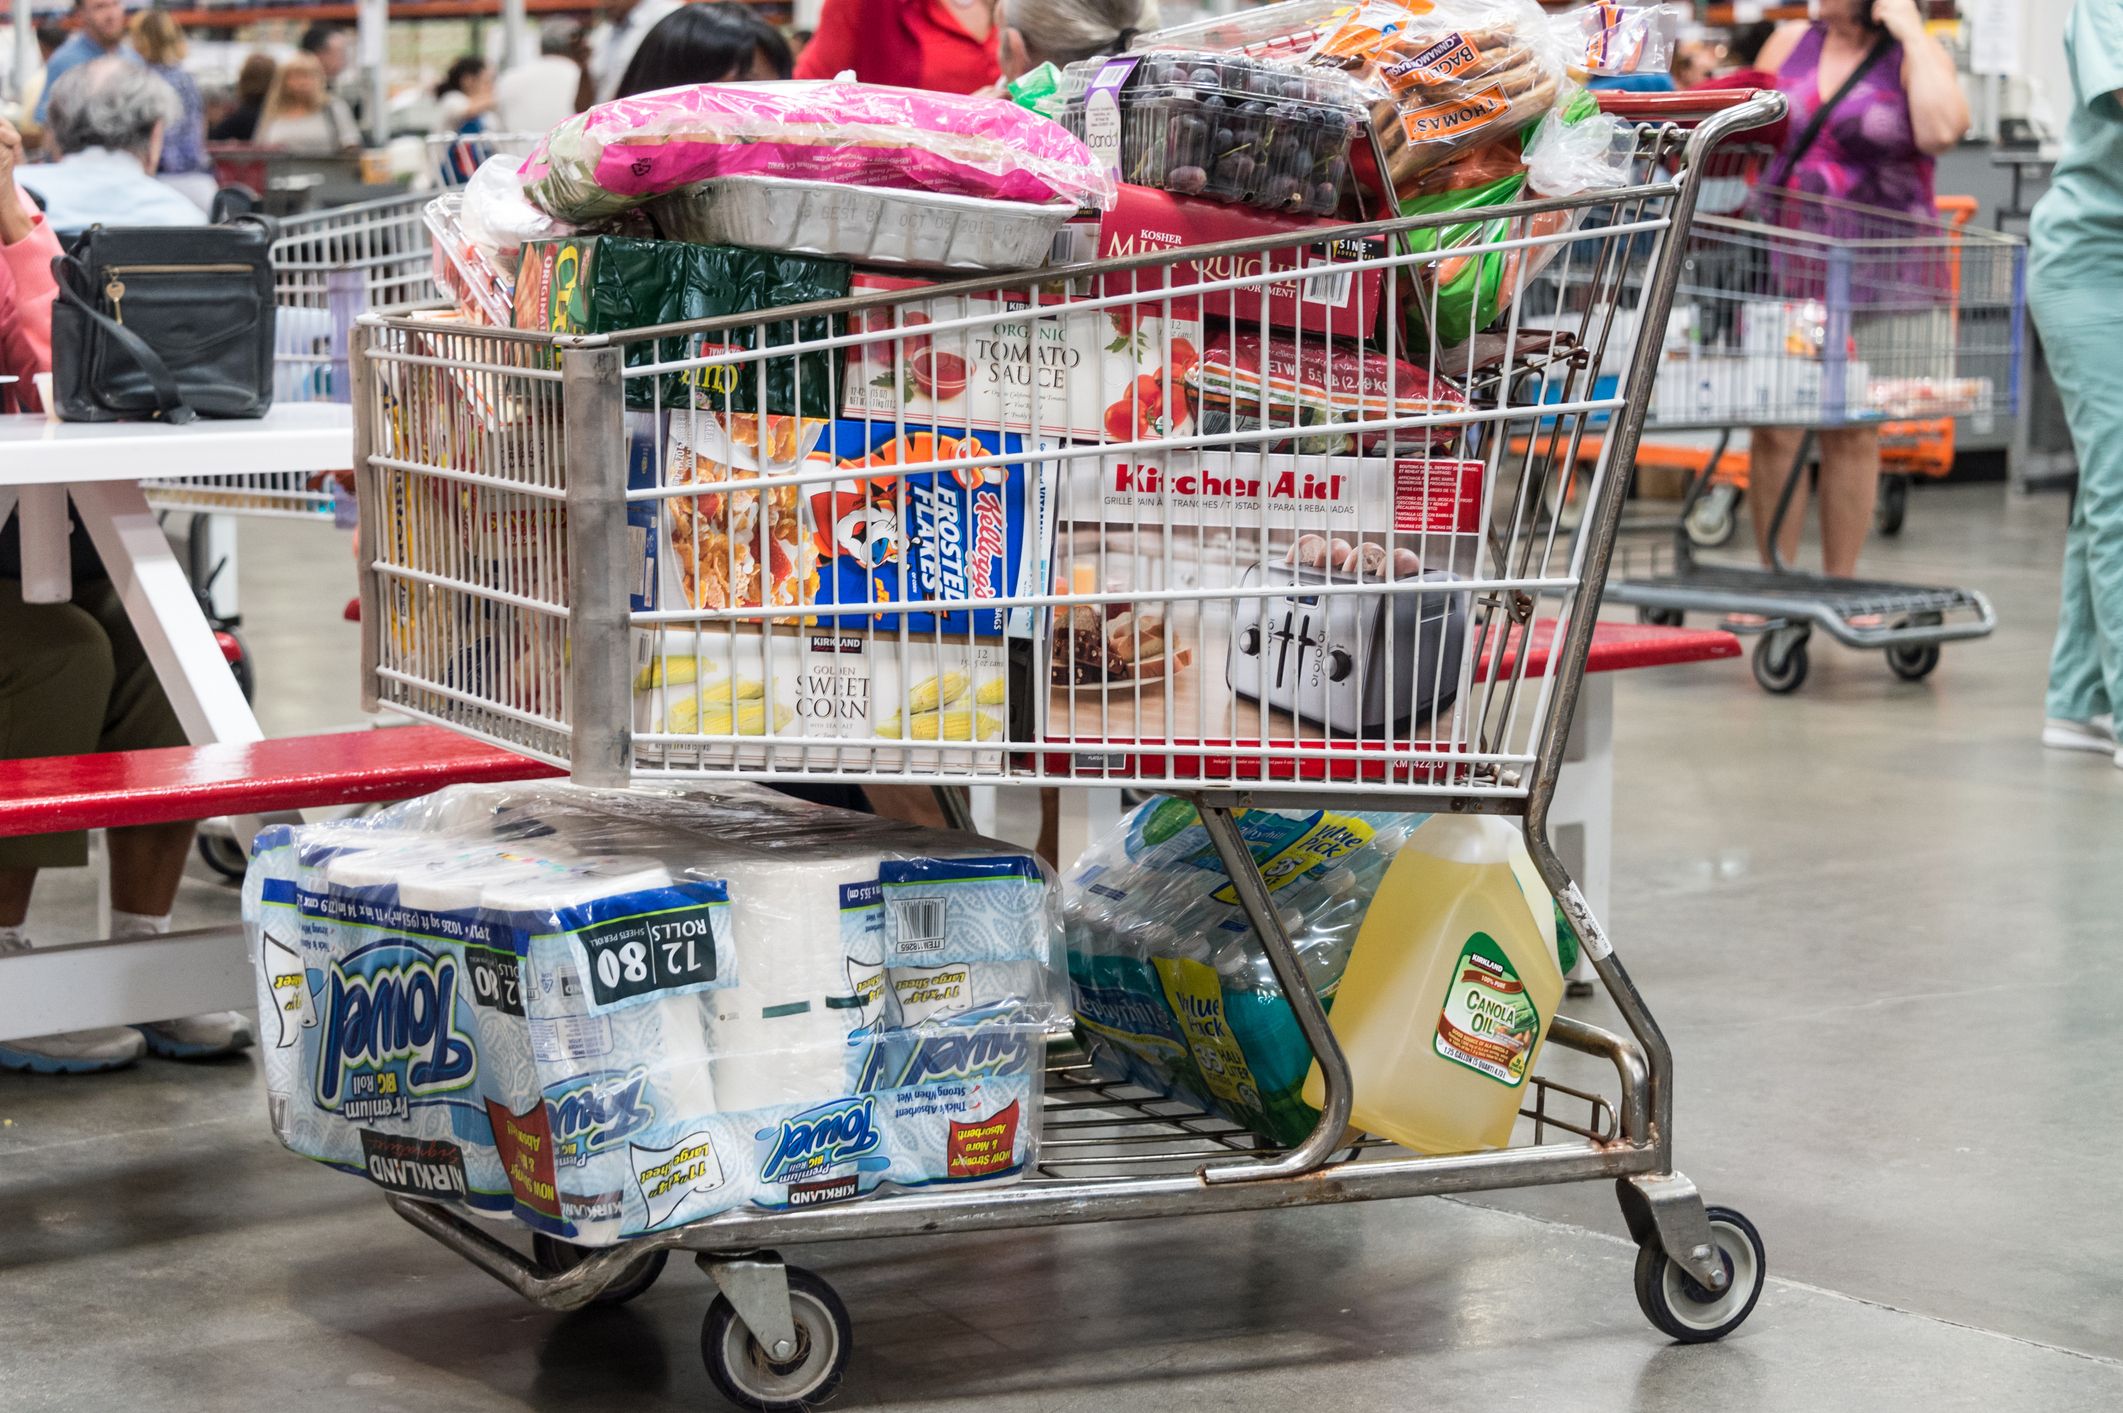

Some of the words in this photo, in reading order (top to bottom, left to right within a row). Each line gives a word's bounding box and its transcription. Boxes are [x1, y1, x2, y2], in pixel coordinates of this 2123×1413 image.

[1140, 229, 1182, 244] KOSHER
[993, 322, 1067, 342] ORGNIC
[975, 338, 1080, 369] TOMATO
[988, 362, 1065, 389] SAUCE
[1115, 463, 1341, 500] KitchenAid
[1227, 500, 1272, 511] TSTADR
[1273, 503, 1296, 512] PARA
[1304, 504, 1355, 514] REBAADAS
[913, 486, 943, 594] FLAKES
[937, 485, 966, 601] FROSTED
[966, 491, 1004, 599] Kellogg's
[813, 637, 861, 648] KIRKAND
[795, 674, 871, 698] SWEET
[796, 697, 869, 719] CORN
[1297, 837, 1343, 858] Pck
[1315, 824, 1363, 849] Vlue
[442, 921, 463, 936] 1026
[651, 918, 708, 942] ROLLS
[498, 963, 520, 979] OLLS
[597, 941, 648, 989] 80
[661, 940, 702, 975] 12
[1471, 953, 1504, 973] KIRKLAND
[895, 977, 929, 991] Sheet
[930, 971, 966, 985] Large
[1481, 975, 1494, 986] 100%
[1176, 991, 1220, 1018] Vlue
[1466, 990, 1514, 1025] CANOLA
[317, 956, 476, 1106] Towel
[1189, 1016, 1226, 1037] Pck
[1471, 1012, 1494, 1035] OIL
[1454, 1050, 1472, 1063] GALLON
[352, 1074, 374, 1096] Roll
[377, 1072, 399, 1095] BIG
[937, 1086, 967, 1097] Strong
[545, 1067, 655, 1148] Tow
[896, 1092, 913, 1102] Wet
[344, 1097, 411, 1123] Premium
[895, 1105, 938, 1118] Absorbent
[761, 1099, 881, 1182] Towel
[965, 1141, 990, 1152] More
[672, 1143, 710, 1166] Large
[786, 1159, 807, 1172] Roll
[807, 1154, 823, 1169] BIG
[993, 1151, 1012, 1165] NOW
[369, 1153, 469, 1198] KIRKLAND
[639, 1160, 672, 1184] heet
[779, 1162, 831, 1184] Premium
[790, 1184, 856, 1205] KIRKLAND
